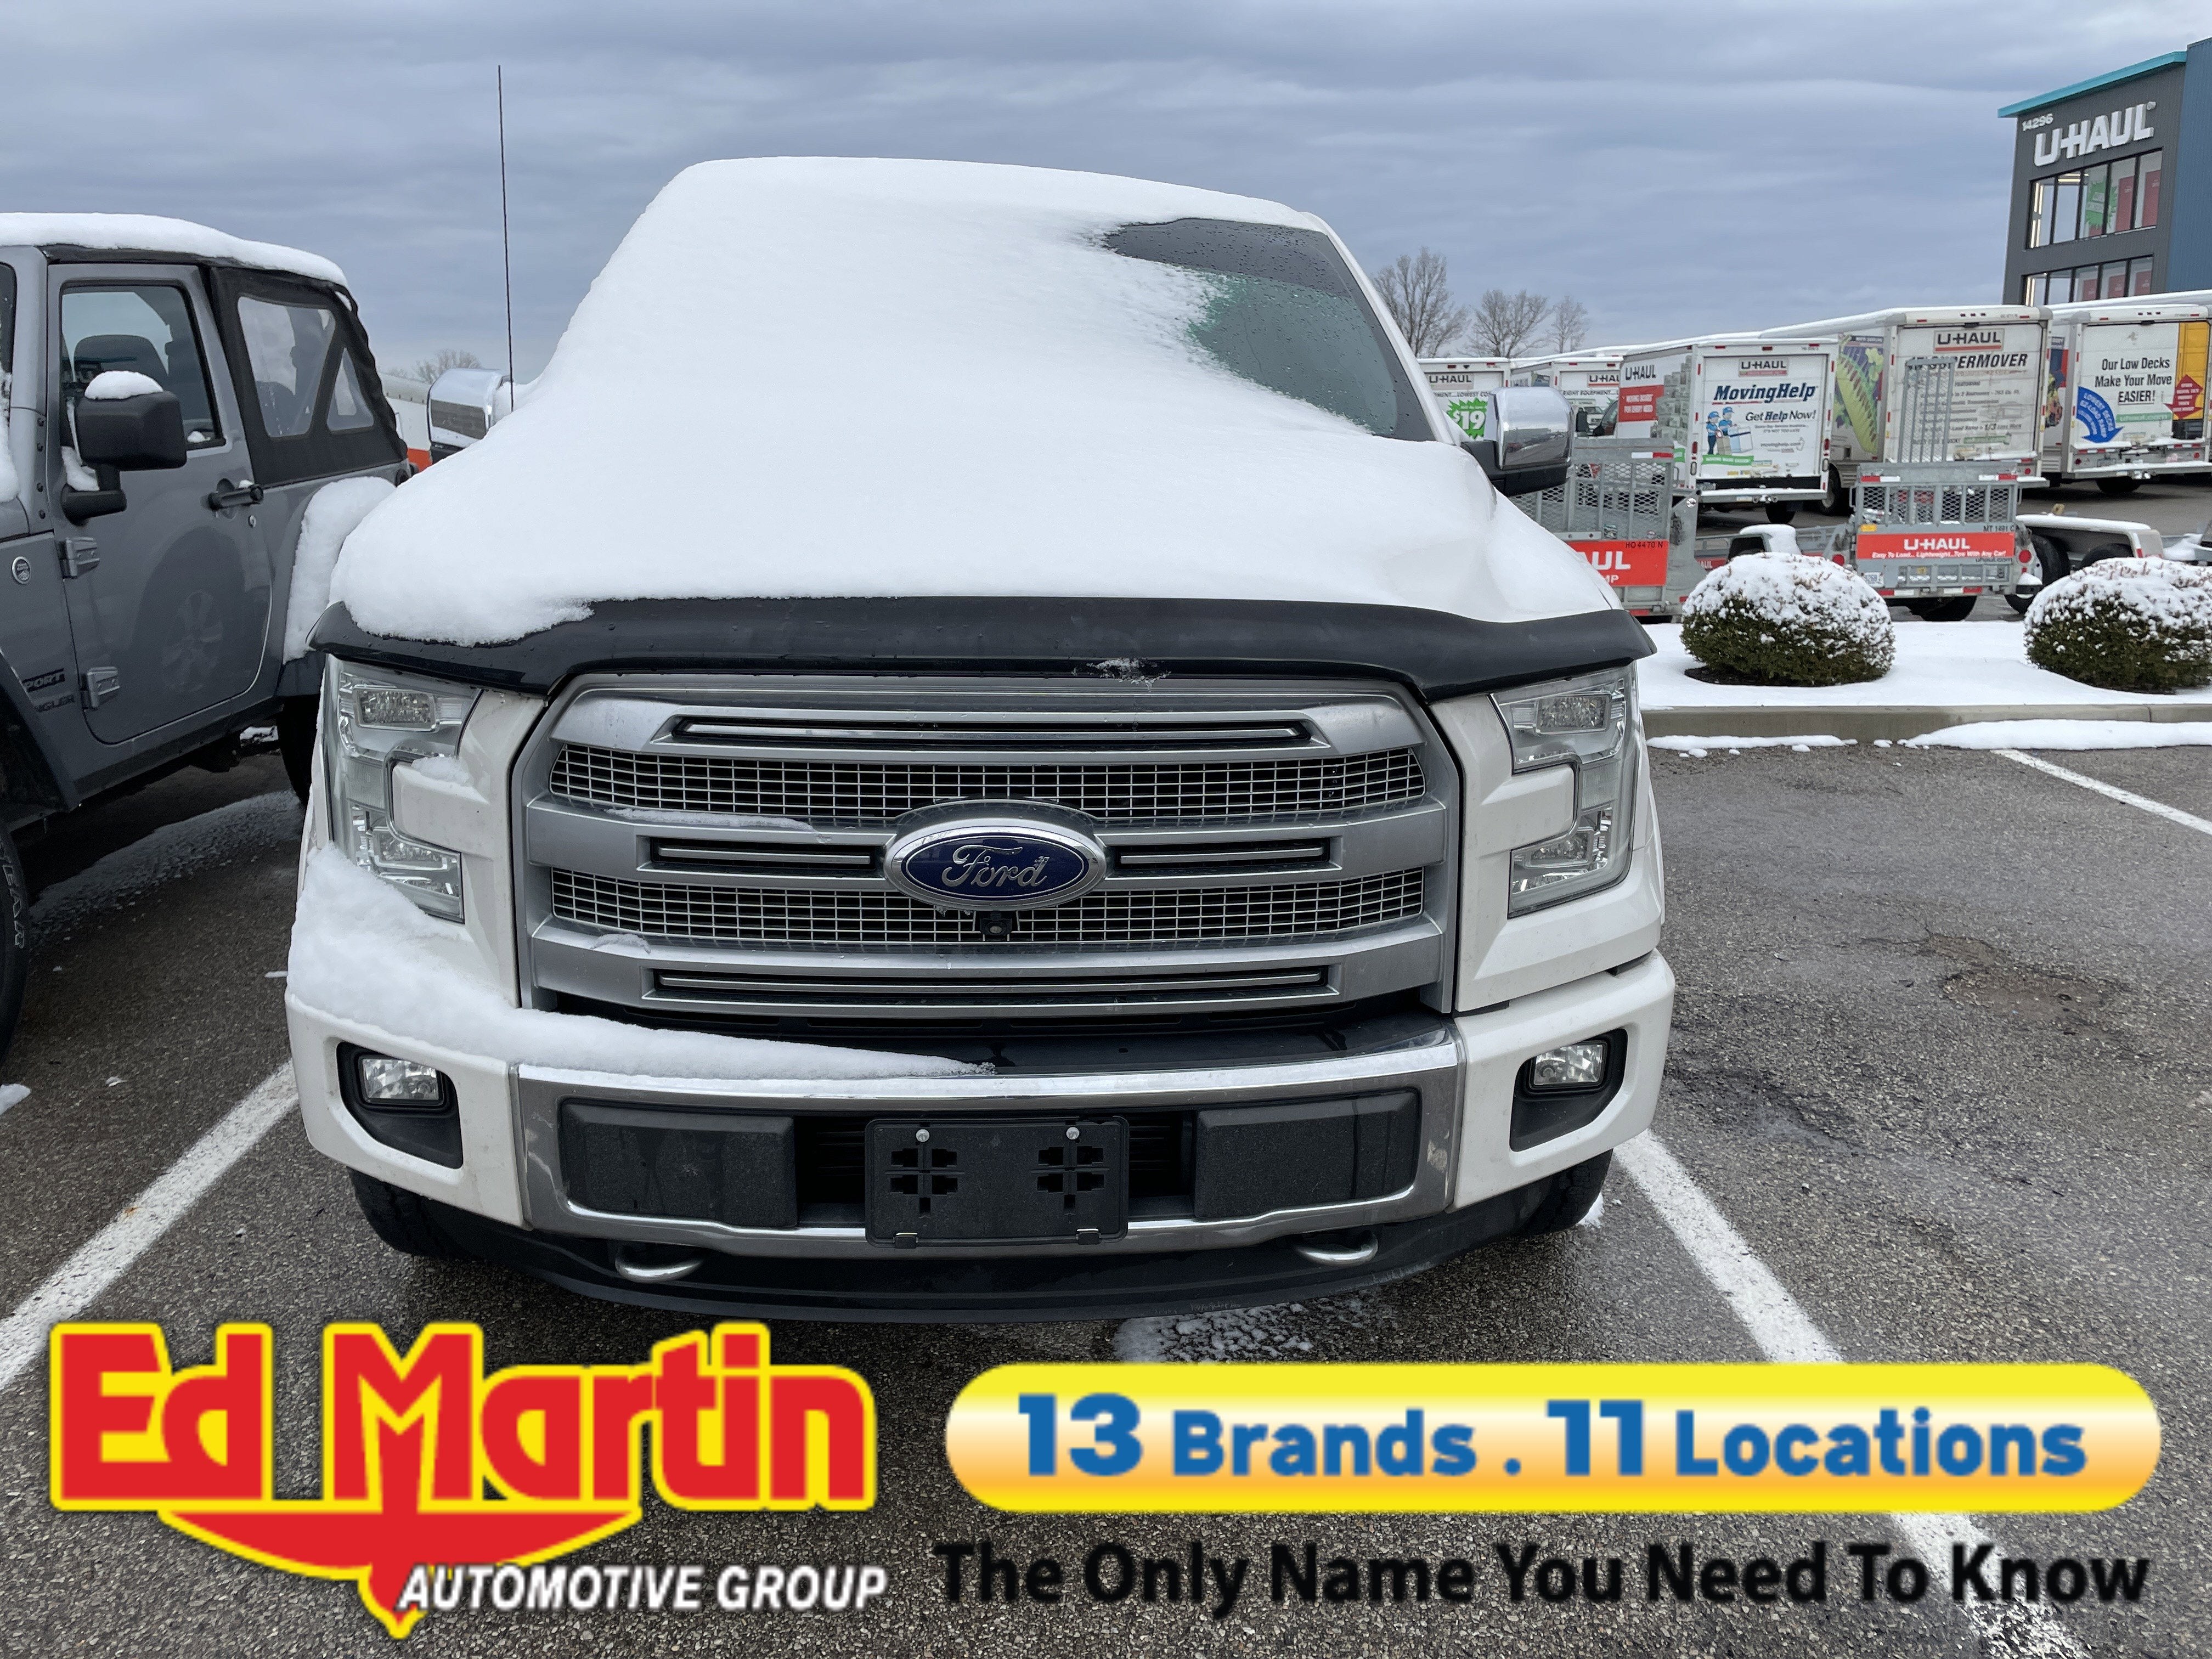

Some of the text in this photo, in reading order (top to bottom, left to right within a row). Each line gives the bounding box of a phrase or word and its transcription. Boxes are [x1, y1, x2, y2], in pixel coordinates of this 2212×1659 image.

[2022, 113, 2053, 132] 14296
[2034, 104, 2154, 167] U-HAUL
[1937, 332, 2001, 345] U-HAUL
[1741, 360, 1787, 369] U-HAUL
[2102, 357, 2170, 370] Our Low Decks
[1429, 375, 1471, 383] U-HAUL
[1626, 365, 1657, 380] U-HAUL
[2095, 374, 2172, 387] Make Your Move
[1713, 382, 1815, 403] MovingHelp
[2118, 390, 2155, 403] EASIER!
[1746, 410, 1816, 423] Get Help Now!
[1904, 538, 1970, 550] U-HAUL
[941, 844, 1050, 887] Ford
